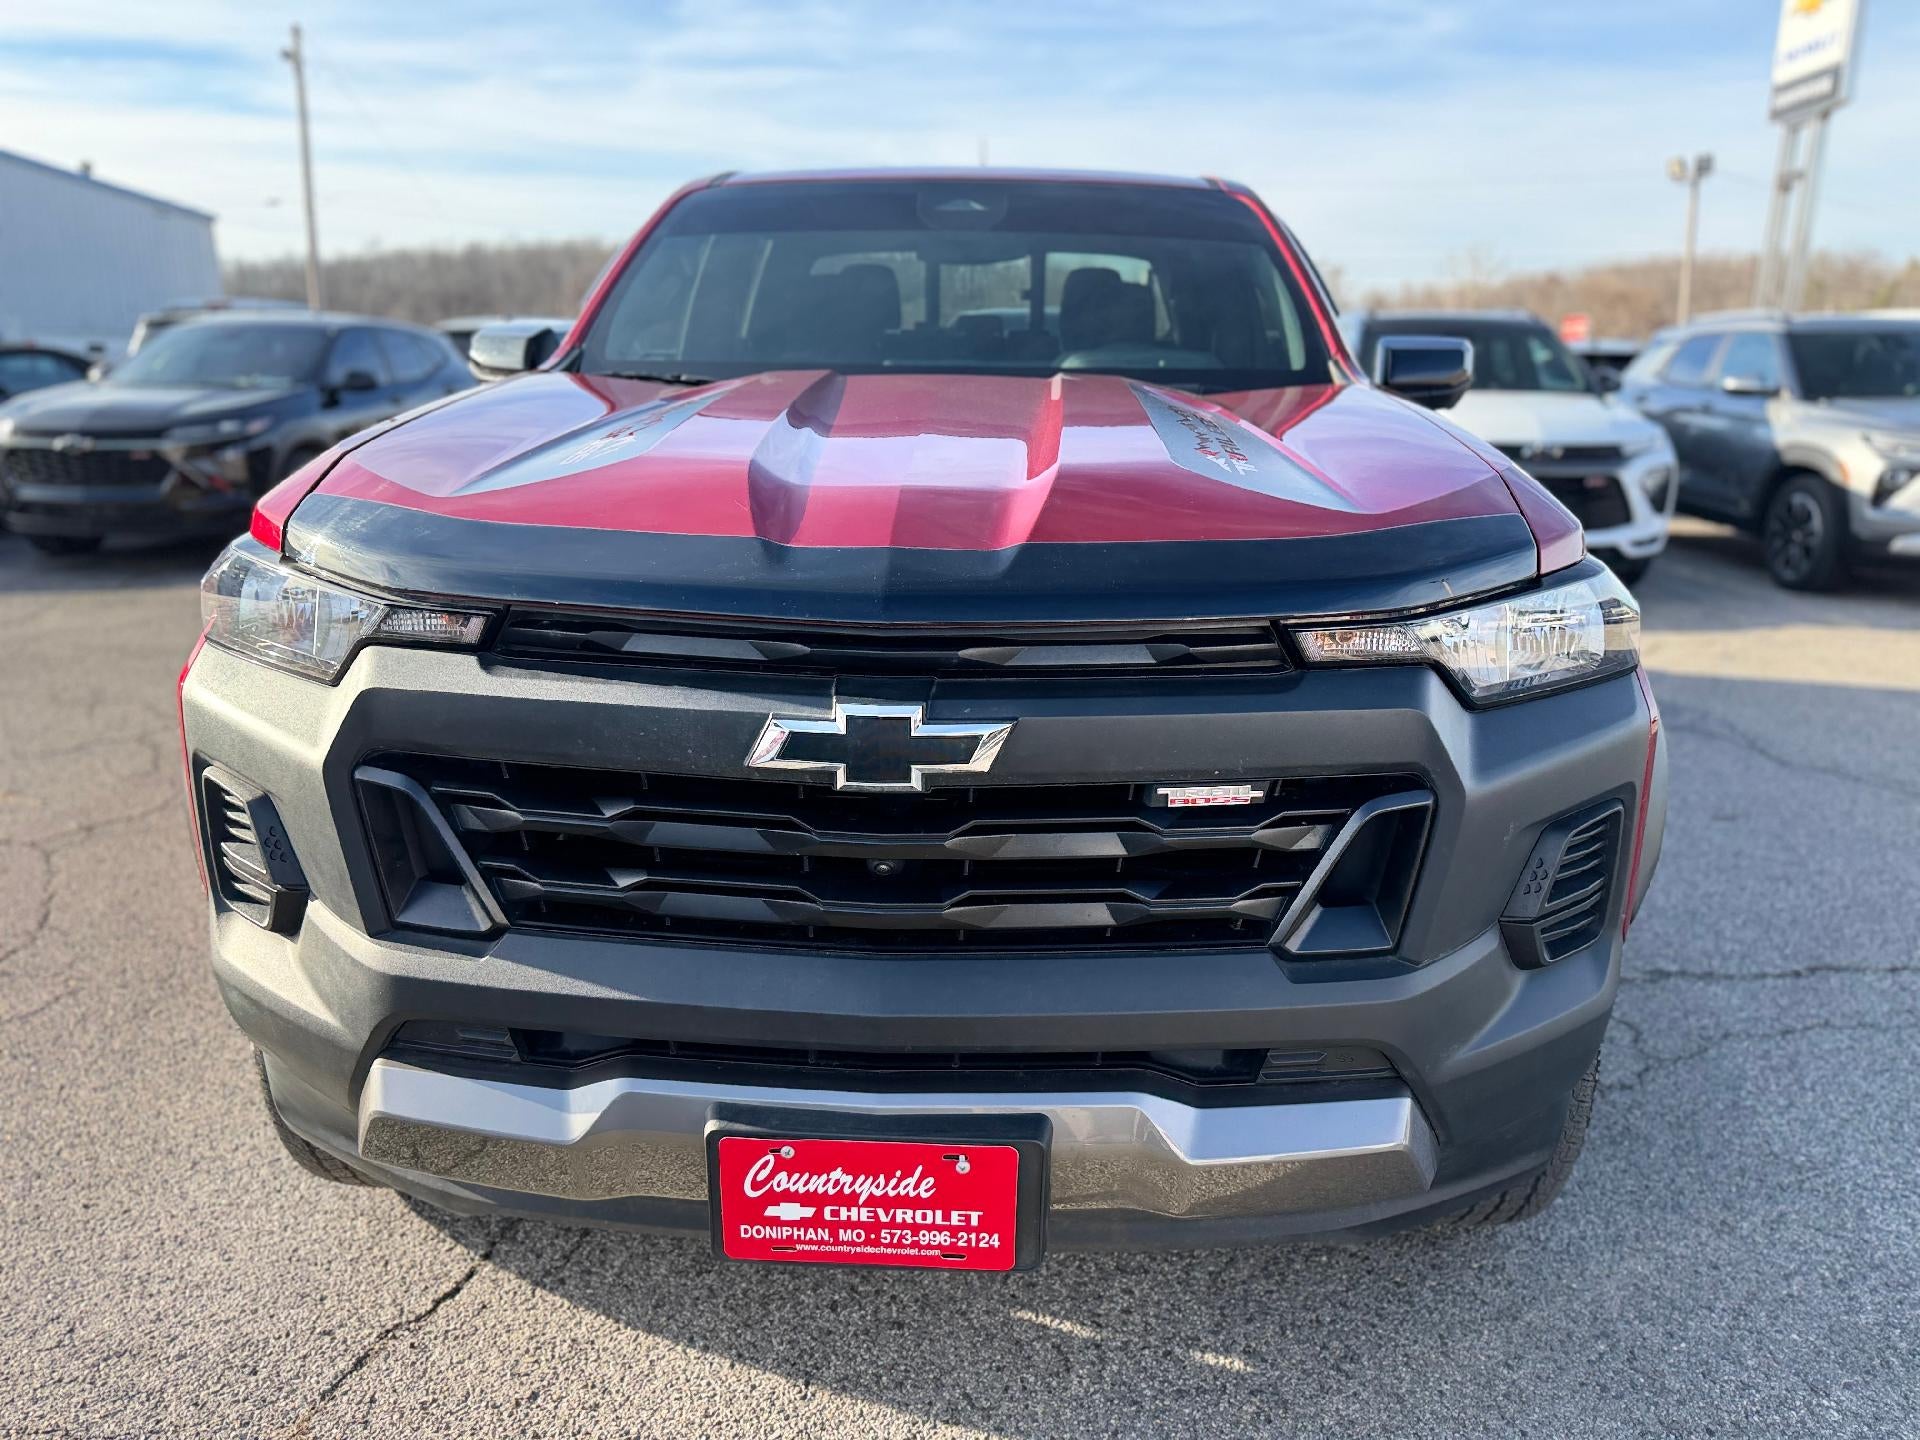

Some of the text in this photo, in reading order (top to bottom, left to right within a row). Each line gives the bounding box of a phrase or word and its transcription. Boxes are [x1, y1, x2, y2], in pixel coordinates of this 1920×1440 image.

[1168, 796, 1251, 807] BOSS
[744, 1154, 937, 1205] Countryside
[823, 1205, 984, 1227] CHEVROLET
[740, 1224, 1000, 1249] DONIPHAN, MO 573-996-2124
[796, 1243, 941, 1257] www.countrysidechevrolet.com
